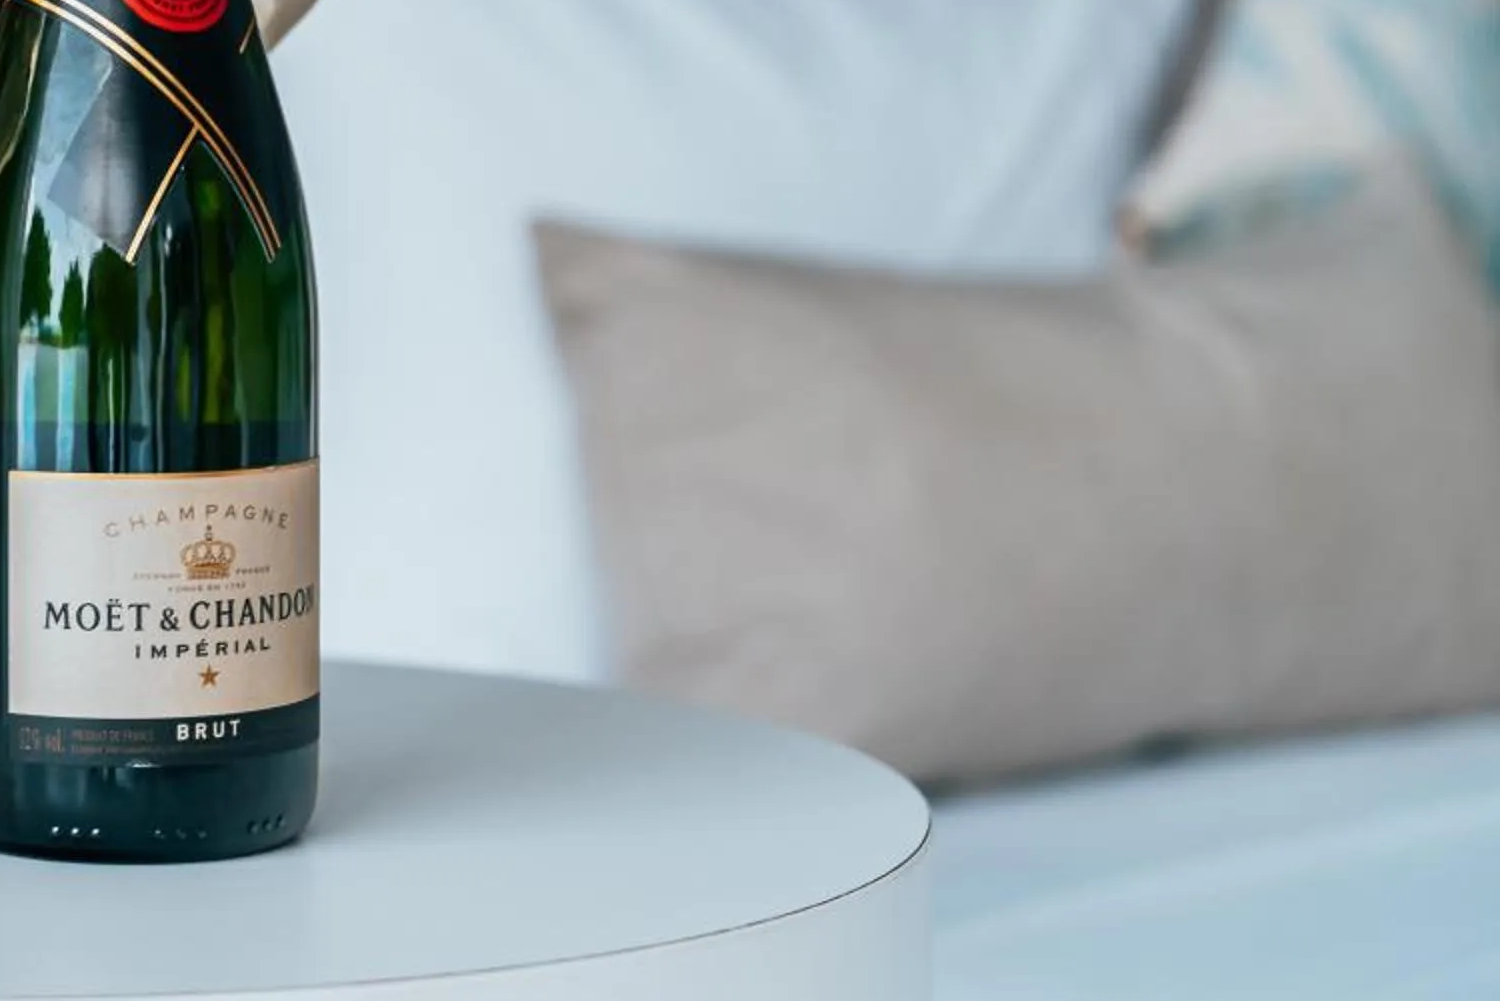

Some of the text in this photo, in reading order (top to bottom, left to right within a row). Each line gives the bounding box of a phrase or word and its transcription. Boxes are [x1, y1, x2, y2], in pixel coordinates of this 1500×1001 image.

[103, 503, 291, 538] CHAMPAGNE
[43, 598, 151, 632] MOËT
[159, 607, 181, 632] &
[135, 636, 271, 660] IMPÉRIAL
[175, 719, 242, 742] BRUT
